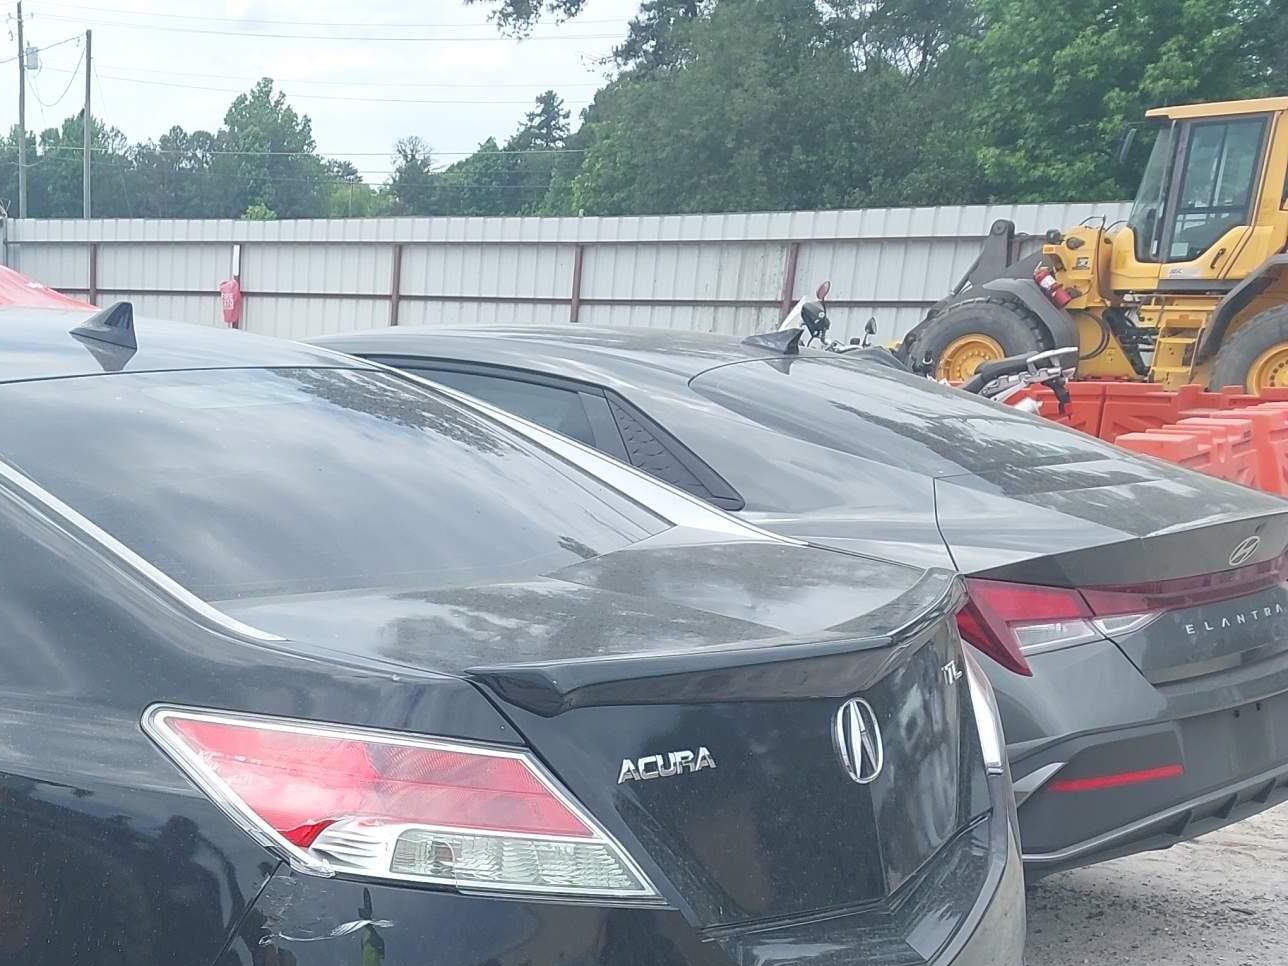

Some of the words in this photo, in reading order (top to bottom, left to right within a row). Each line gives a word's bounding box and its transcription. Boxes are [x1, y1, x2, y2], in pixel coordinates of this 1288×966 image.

[1185, 603, 1283, 635] ELANTRA
[941, 659, 963, 686] TL
[617, 746, 717, 785] ACURA
